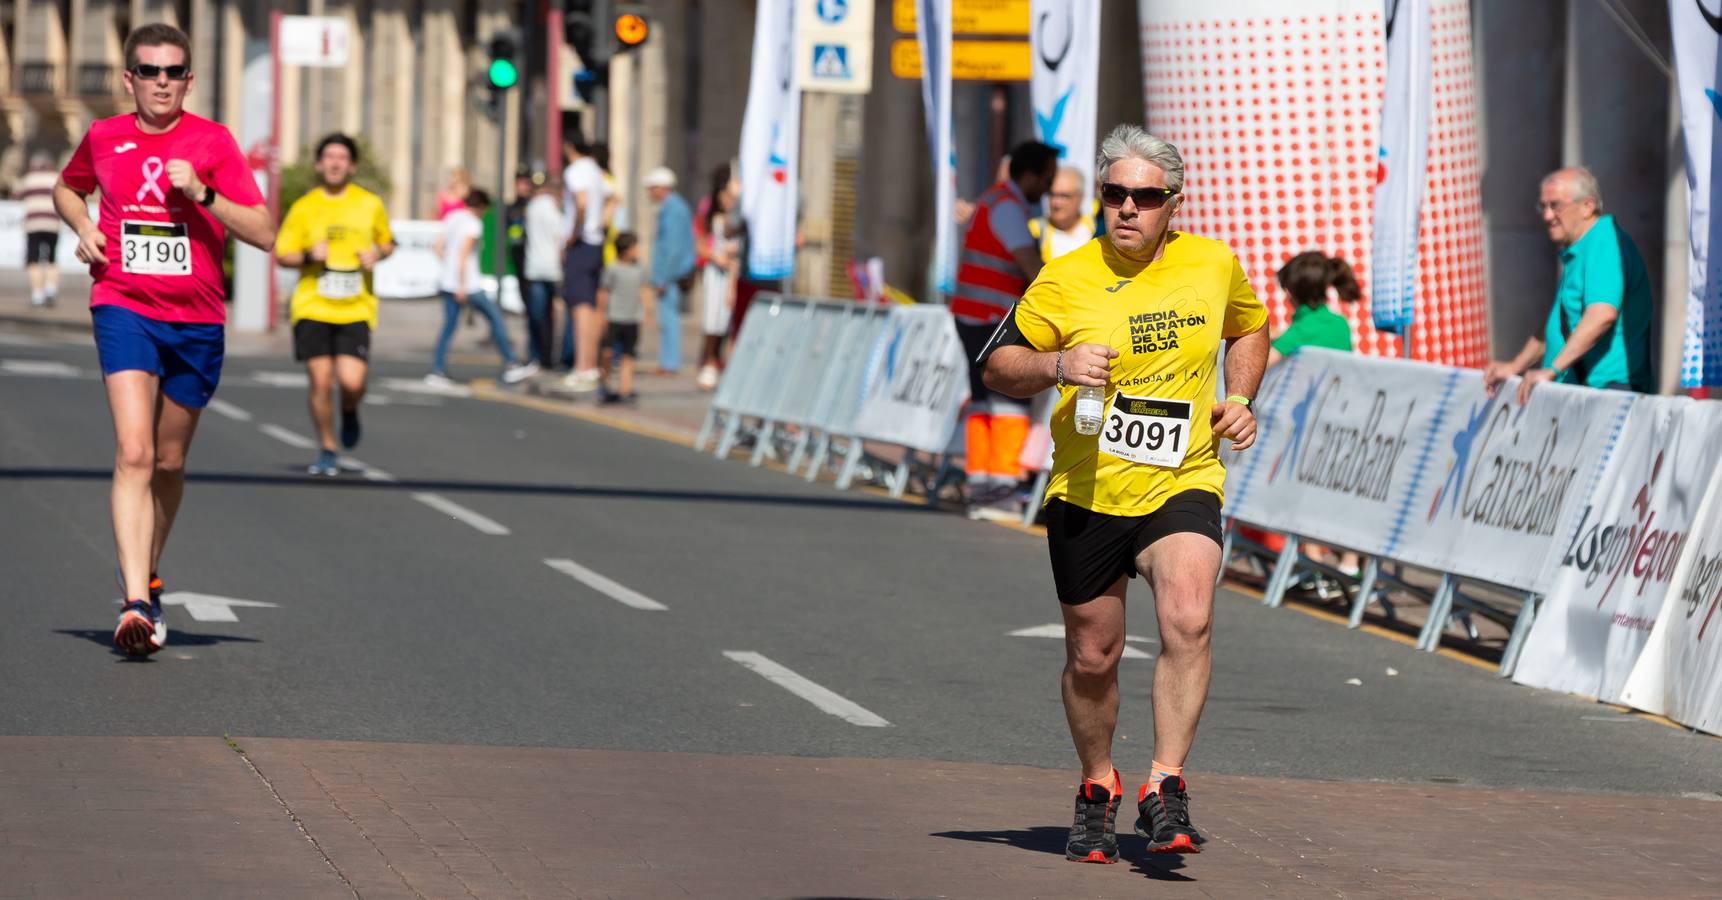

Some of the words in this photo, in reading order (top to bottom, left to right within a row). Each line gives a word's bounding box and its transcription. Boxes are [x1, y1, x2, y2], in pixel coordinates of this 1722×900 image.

[125, 240, 186, 262] 3190
[1129, 310, 1178, 325] MEDIA
[1130, 314, 1205, 335] MARATÓN
[1131, 334, 1151, 345] DE
[1157, 330, 1178, 341] LA
[1133, 340, 1179, 355] RIOJA
[1133, 374, 1163, 386] RIOJA
[1105, 414, 1182, 453] 3091
